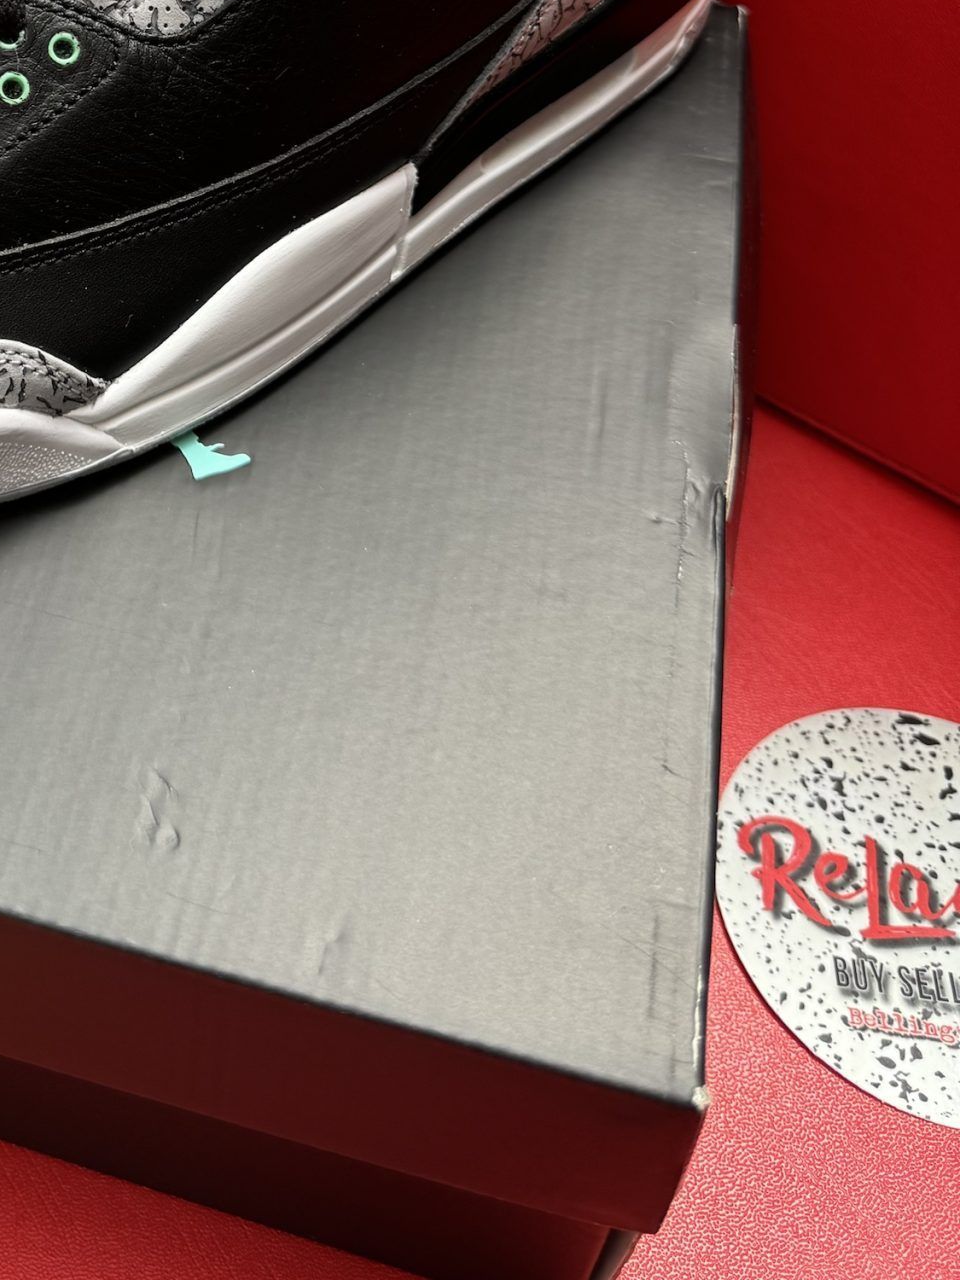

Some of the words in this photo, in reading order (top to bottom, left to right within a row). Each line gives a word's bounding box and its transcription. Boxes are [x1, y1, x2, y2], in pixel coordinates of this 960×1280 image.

[737, 815, 960, 939] ReLa
[833, 955, 884, 993] BUY
[898, 965, 960, 1004] SELL
[846, 1006, 960, 1045] Belling
